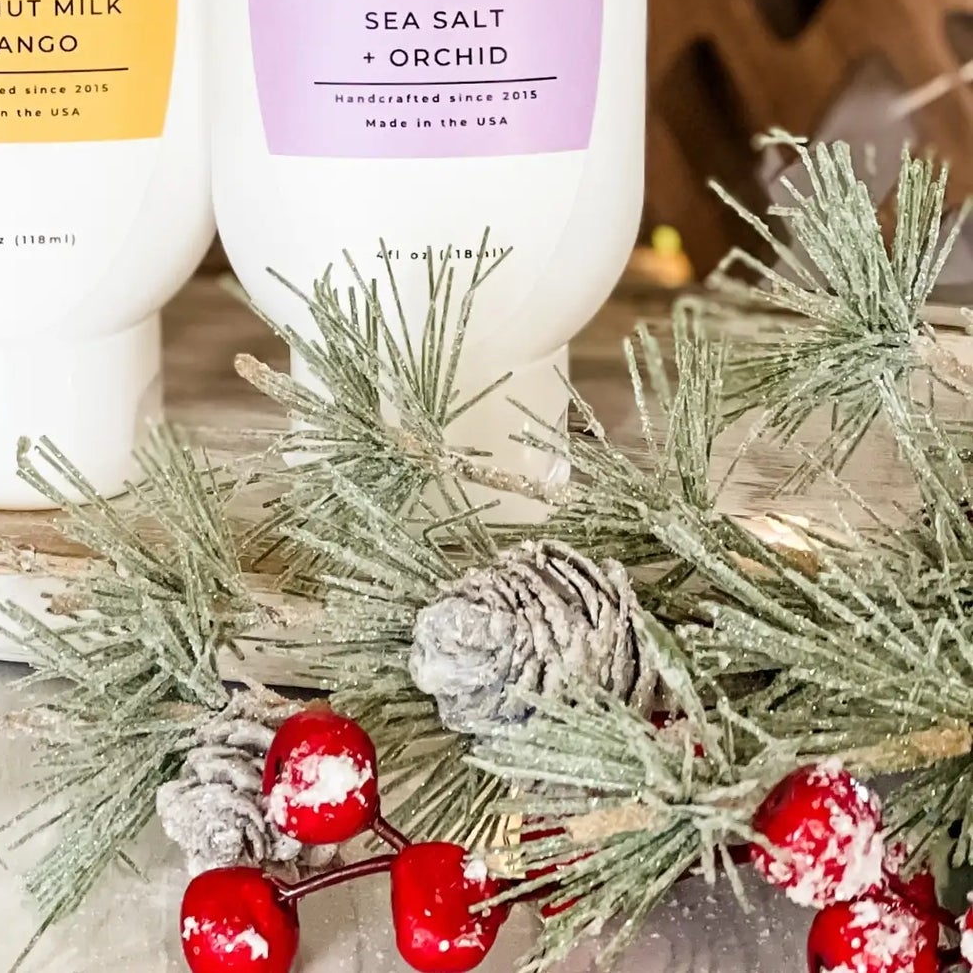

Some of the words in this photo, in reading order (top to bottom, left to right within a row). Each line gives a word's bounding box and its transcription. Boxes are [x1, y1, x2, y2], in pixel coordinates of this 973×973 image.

[365, 12, 419, 30] SEA
[433, 9, 504, 29] SALT
[363, 52, 374, 63] +
[390, 46, 507, 67] ORCHID
[25, 85, 66, 95] since
[75, 84, 109, 93] 2015
[335, 93, 440, 104] Handcrafted
[449, 92, 493, 103] since
[503, 90, 538, 101] 2015
[17, 108, 42, 117] the
[51, 107, 80, 116] USA
[366, 119, 407, 128] Made
[417, 118, 431, 127] in
[441, 118, 467, 127] the
[477, 117, 507, 126] USA
[15, 234, 76, 246] (118ml)
